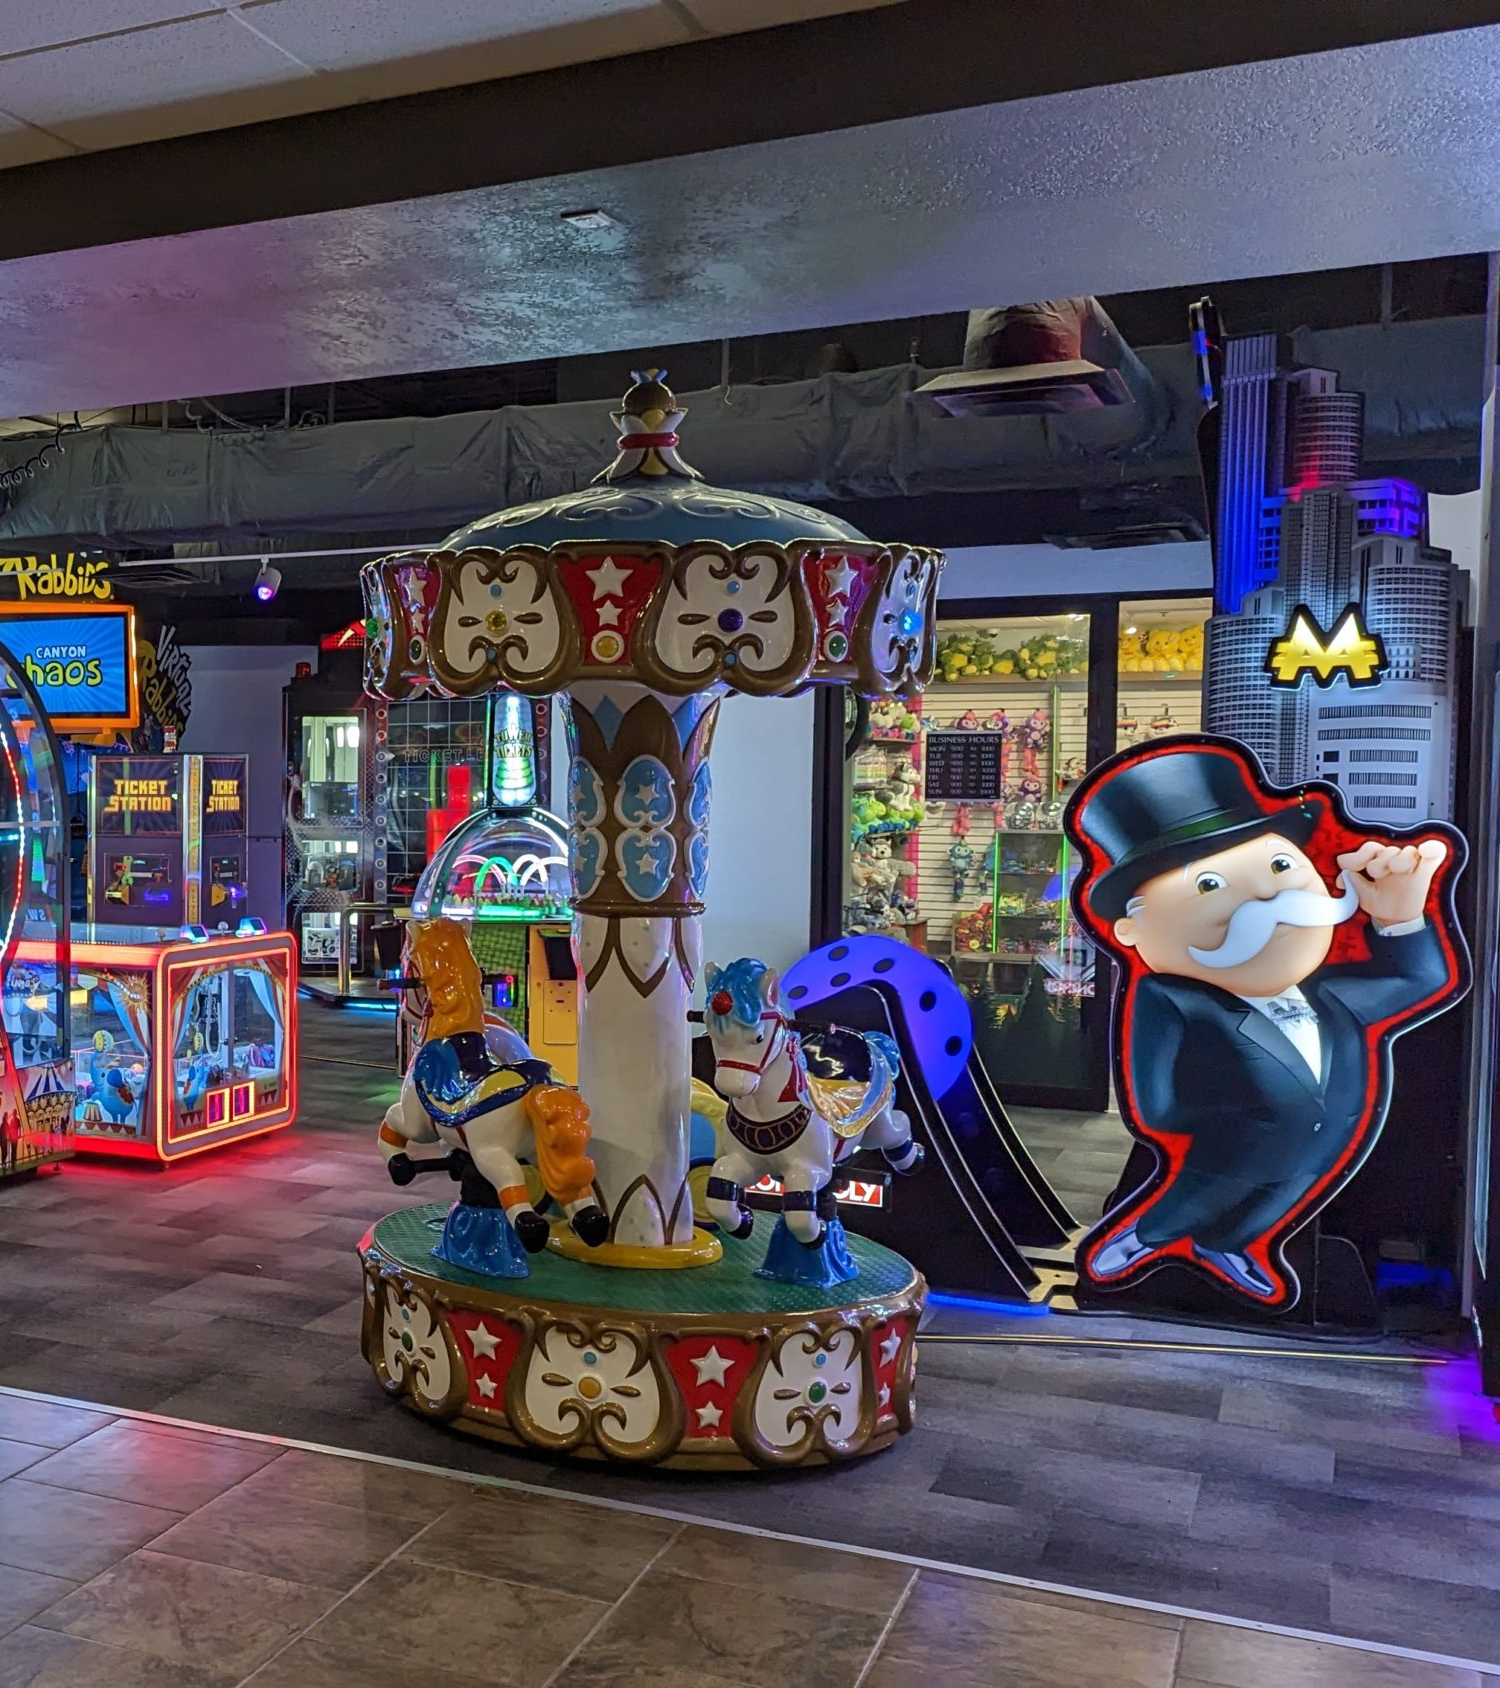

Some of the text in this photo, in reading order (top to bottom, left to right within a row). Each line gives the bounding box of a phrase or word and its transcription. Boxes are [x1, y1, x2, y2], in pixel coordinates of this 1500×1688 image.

[36, 646, 86, 659] CANYON
[404, 749, 461, 762] TICKET
[494, 743, 533, 758] TICKETS
[114, 780, 168, 795] TICKET
[212, 780, 238, 795] TICKET
[104, 796, 172, 813] STATION
[206, 796, 240, 813] STATION
